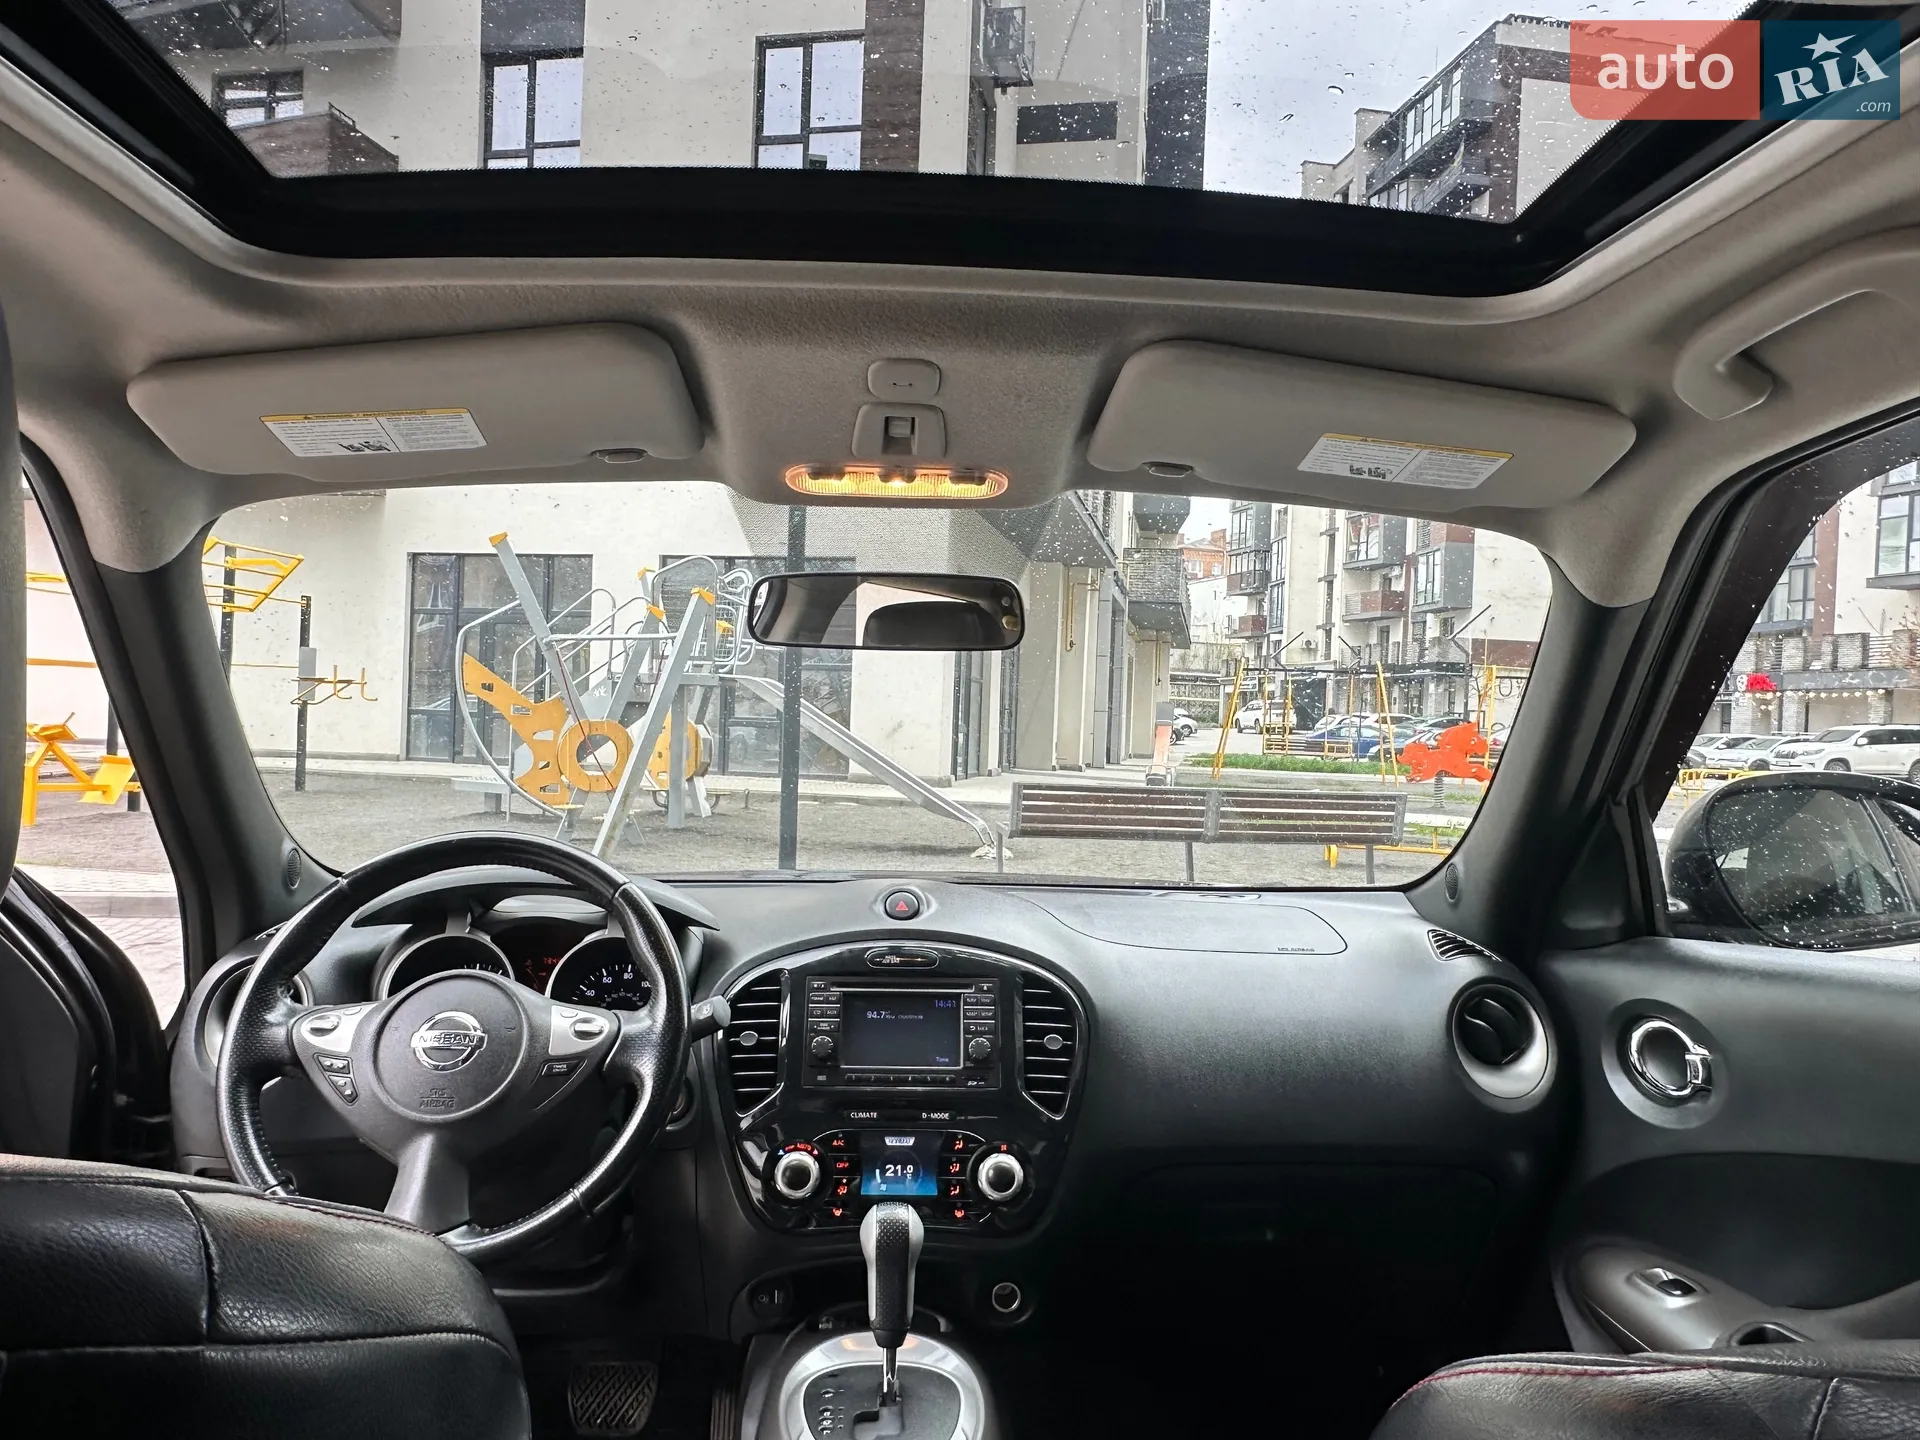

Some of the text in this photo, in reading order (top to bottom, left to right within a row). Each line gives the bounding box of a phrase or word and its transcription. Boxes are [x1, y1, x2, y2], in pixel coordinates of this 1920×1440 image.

[602, 976, 613, 984] 60
[623, 972, 634, 980] 80
[866, 1010, 886, 1019] 94.7
[419, 1033, 477, 1045] NISSAN
[921, 1112, 950, 1120] D-MODE
[885, 1164, 914, 1177] 21.0
